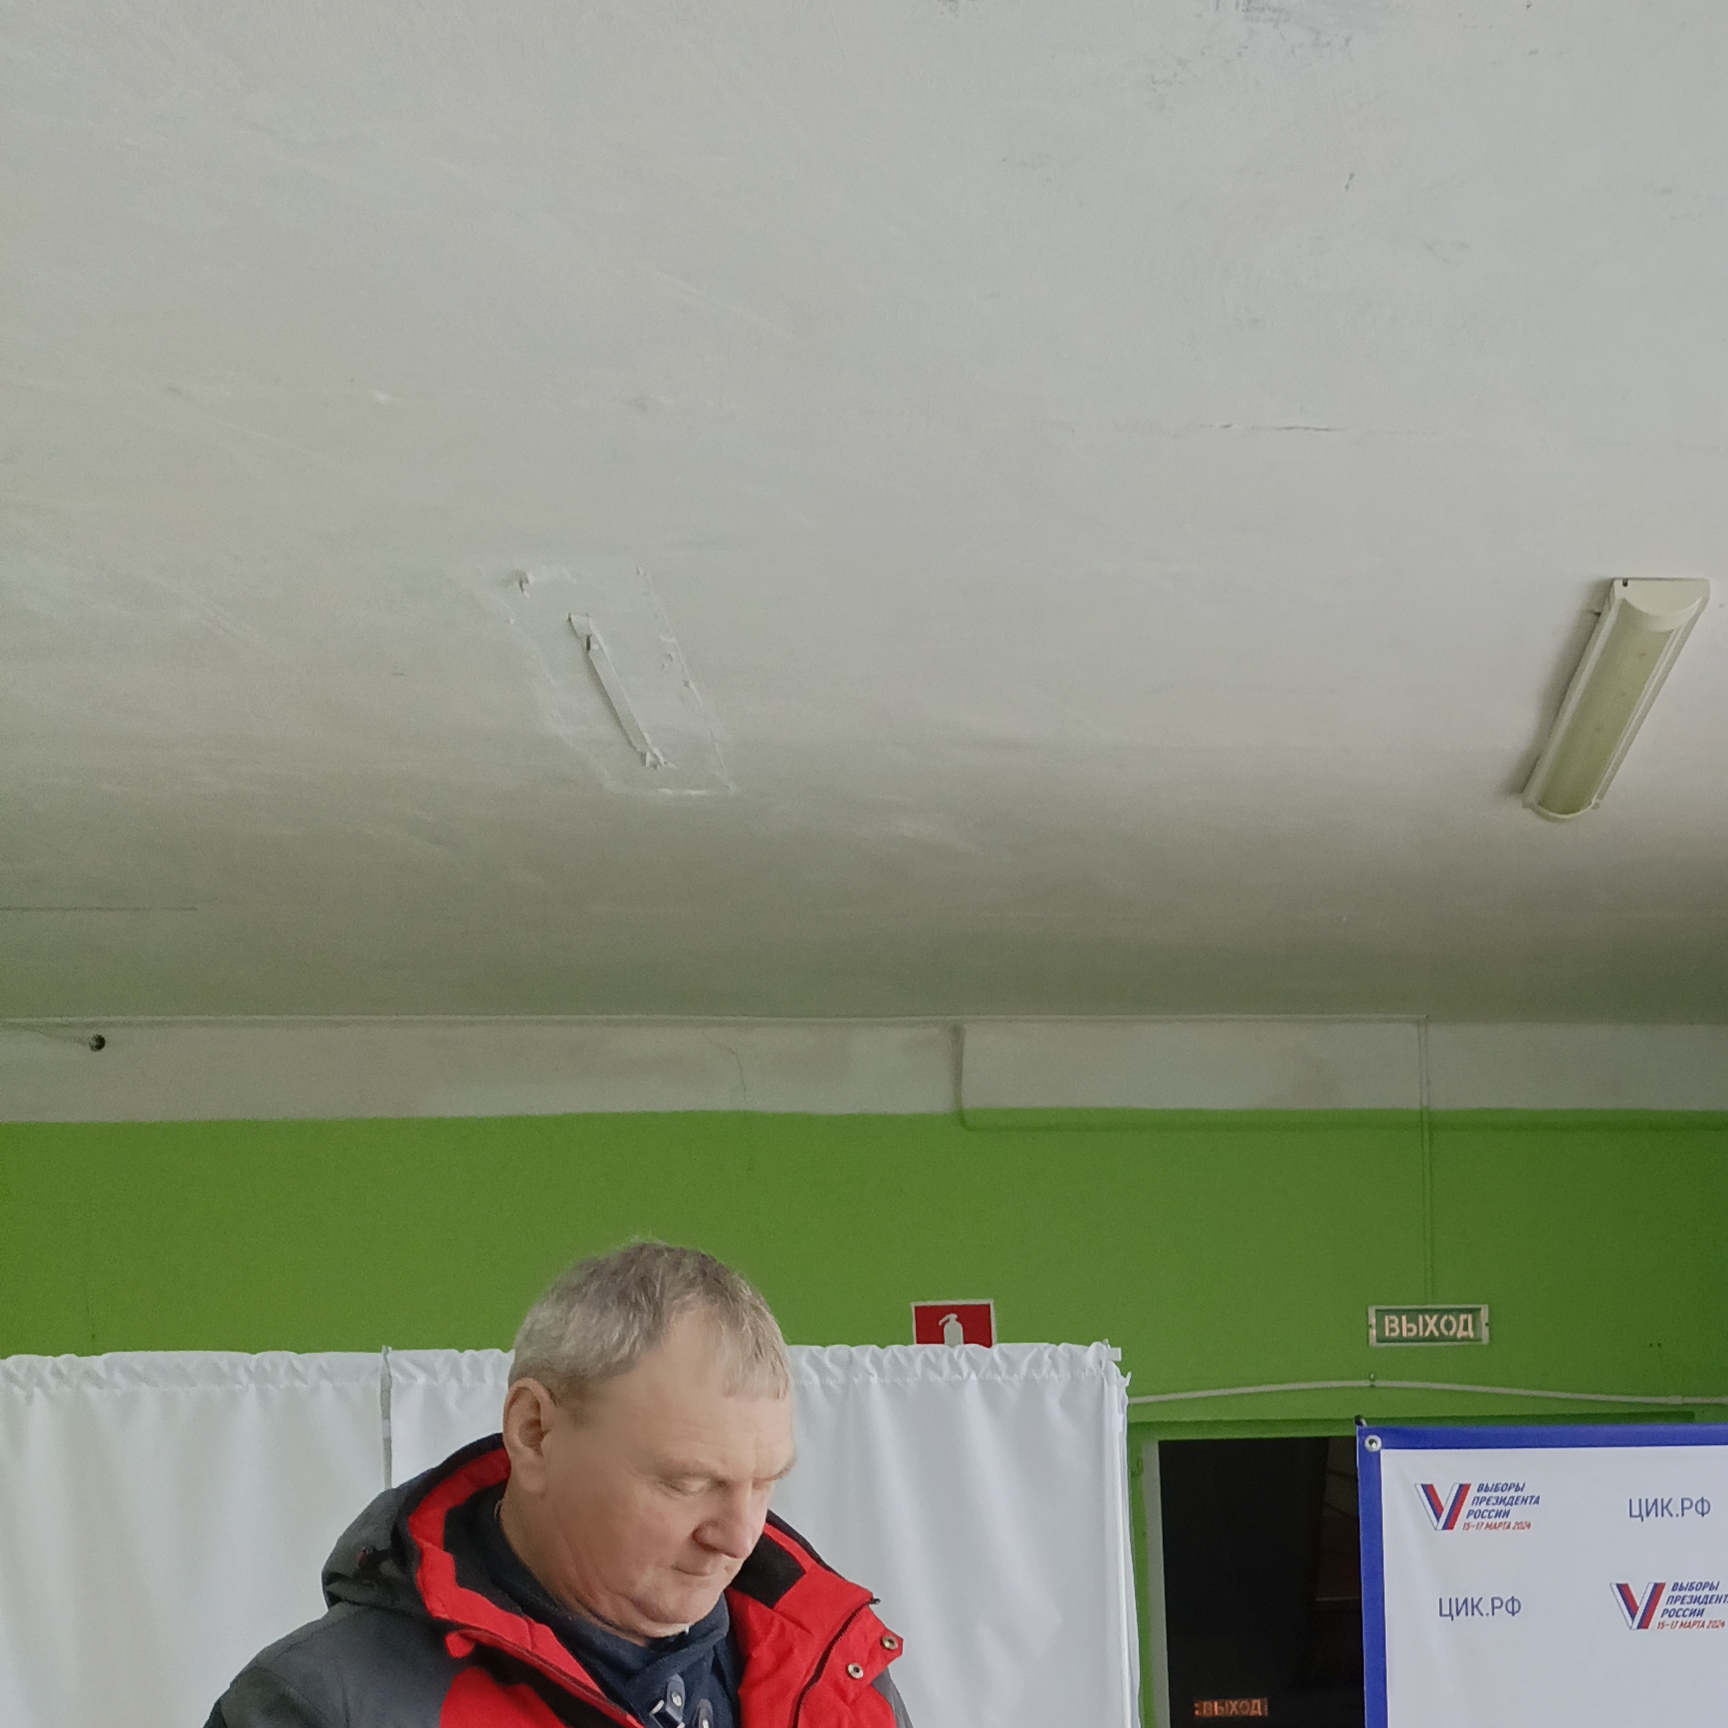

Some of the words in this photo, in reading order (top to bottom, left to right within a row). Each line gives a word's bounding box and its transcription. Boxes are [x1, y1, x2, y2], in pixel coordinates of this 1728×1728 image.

[1384, 1314, 1474, 1339] ВЫХОД
[1476, 1482, 1526, 1493] ВЫБОРЫ
[1471, 1494, 1541, 1507] ПРЕЗИДЕНТА
[1465, 1508, 1511, 1520] РОССИИ
[1629, 1497, 1710, 1522] ЦИК.РФ
[1485, 1521, 1511, 1531] МАРТА
[1513, 1521, 1532, 1531] 2024
[1670, 1581, 1721, 1592] ВЫБОРЫ
[1439, 1596, 1521, 1621] ЦИК.РФ
[1660, 1607, 1706, 1619] РОССИИ
[1679, 1620, 1705, 1630] МАРТА
[1707, 1619, 1726, 1629] 2024
[1203, 1700, 1262, 1716] ВЫХОД
